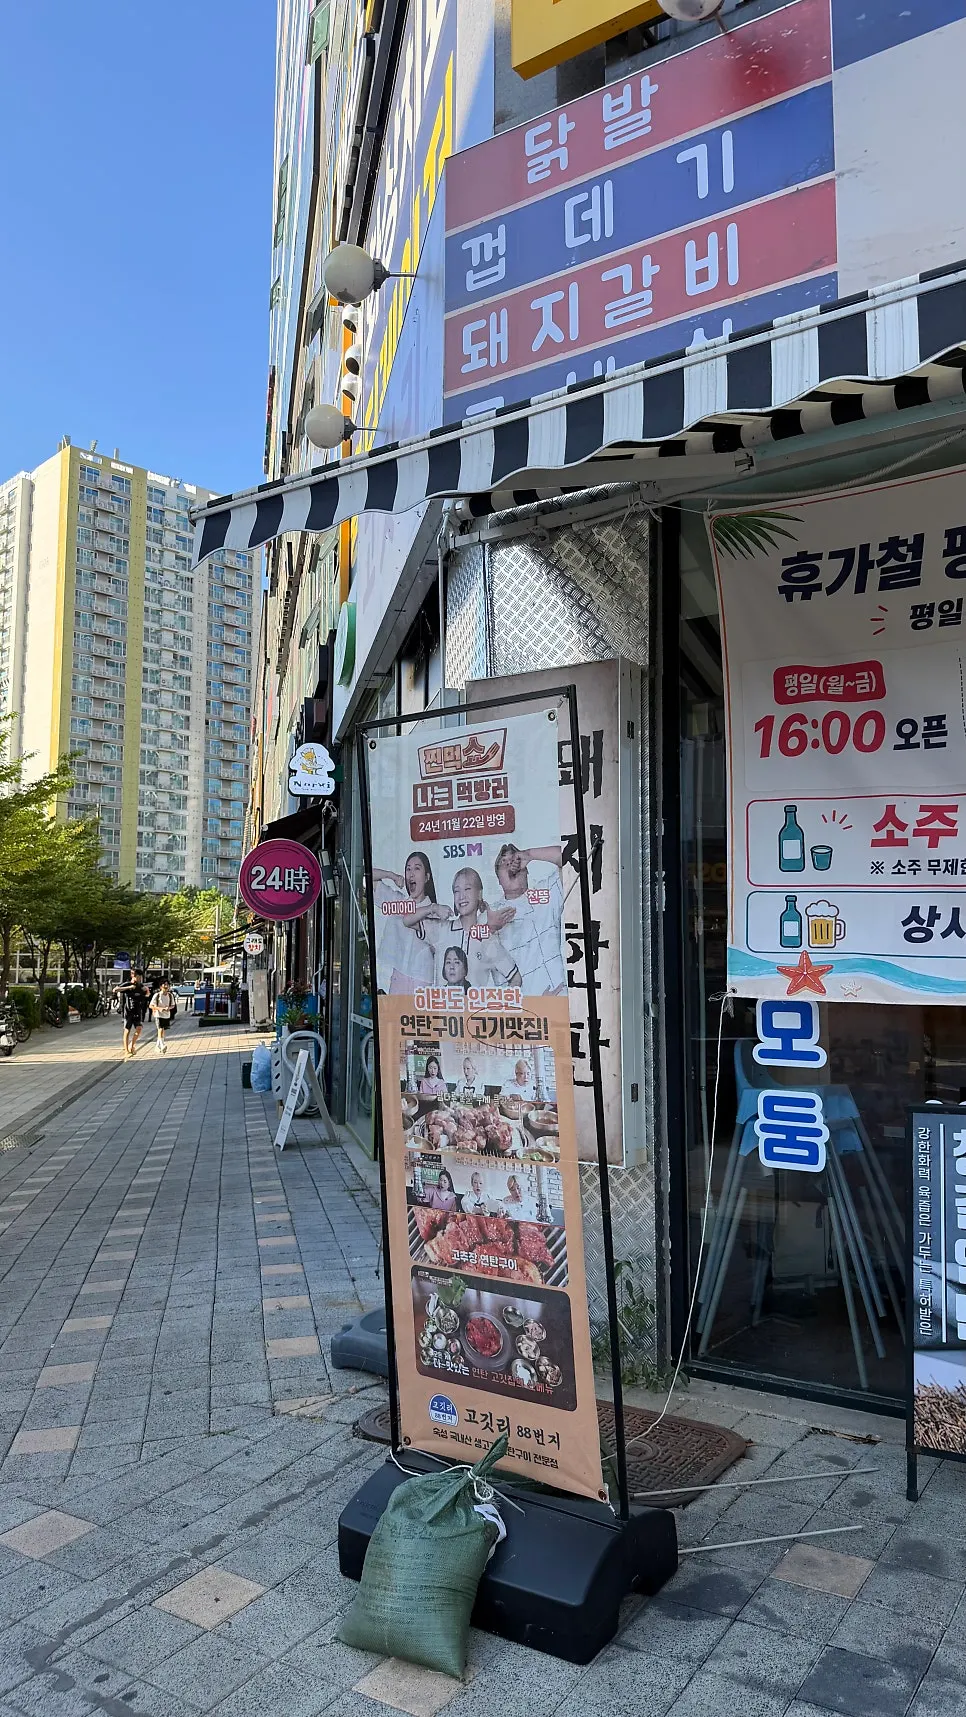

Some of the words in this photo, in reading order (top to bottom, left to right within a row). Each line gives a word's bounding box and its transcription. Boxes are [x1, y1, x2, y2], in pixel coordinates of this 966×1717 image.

[460, 222, 739, 375] 돼지갈비
[777, 533, 925, 602] 휴가철
[909, 597, 964, 631] 평일
[784, 671, 877, 697] 평일(월~금)
[753, 709, 886, 759] 16:00
[892, 713, 948, 751] 오픈
[417, 785, 449, 807] 나는
[457, 776, 509, 802] 먹방러
[419, 820, 440, 833] 24년
[442, 817, 461, 831] 11월
[463, 814, 485, 829] 22일
[486, 812, 506, 828] 방영
[870, 804, 959, 848] 소주
[443, 844, 465, 858] SBS
[250, 865, 310, 894] 24時
[891, 859, 922, 876] 소주
[470, 926, 491, 939] 히밥
[415, 987, 464, 1011] 히밥도
[468, 988, 521, 1014] 인정한
[400, 1015, 464, 1038] 연탄구이
[471, 1016, 549, 1041] 고기맛집!
[756, 1001, 828, 1169] 모둠
[918, 1127, 931, 1180] 강한화력
[451, 1250, 478, 1263] 고추장
[480, 1253, 517, 1270] 연탄구이
[919, 1232, 932, 1272] 가두는
[919, 1279, 932, 1336] 특허받은
[472, 1368, 488, 1380] 연탄
[433, 1427, 448, 1439] 숙성
[450, 1430, 472, 1446] 국내산
[533, 1453, 559, 1469] 전문점
[517, 1425, 560, 1450] 88번지
